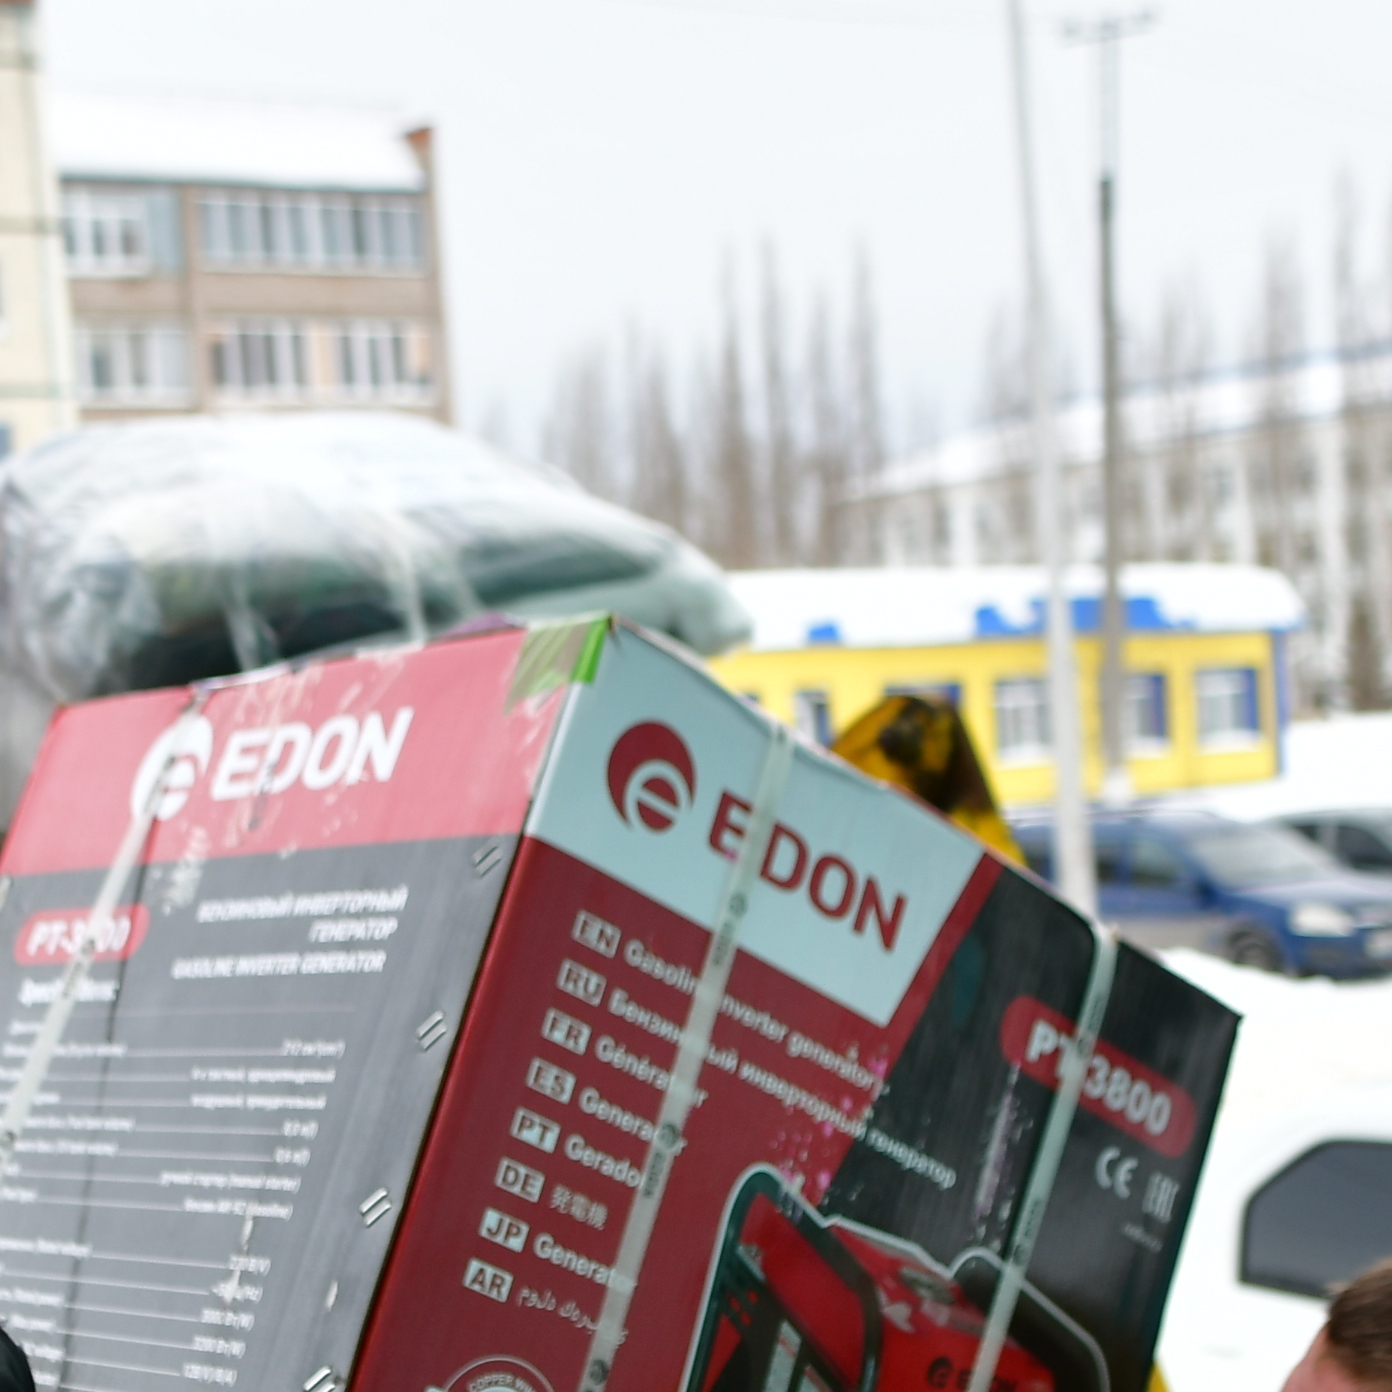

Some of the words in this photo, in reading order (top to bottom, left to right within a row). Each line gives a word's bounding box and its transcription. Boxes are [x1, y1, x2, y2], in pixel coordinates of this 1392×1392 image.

[210, 706, 414, 802] EDON
[707, 788, 908, 953] EDON
[26, 914, 132, 957] PT-300
[576, 915, 617, 952] EN
[718, 992, 789, 1043] nverter
[786, 1030, 876, 1091] generator
[546, 1013, 586, 1050] FR
[530, 1062, 568, 1101] ES
[561, 963, 603, 1001] RU
[738, 1059, 869, 1141] инверторный
[866, 1126, 957, 1191] генератор
[515, 1112, 556, 1147] PT
[498, 1163, 540, 1198] DE
[484, 1214, 524, 1247] JP
[466, 1265, 509, 1299] AR
